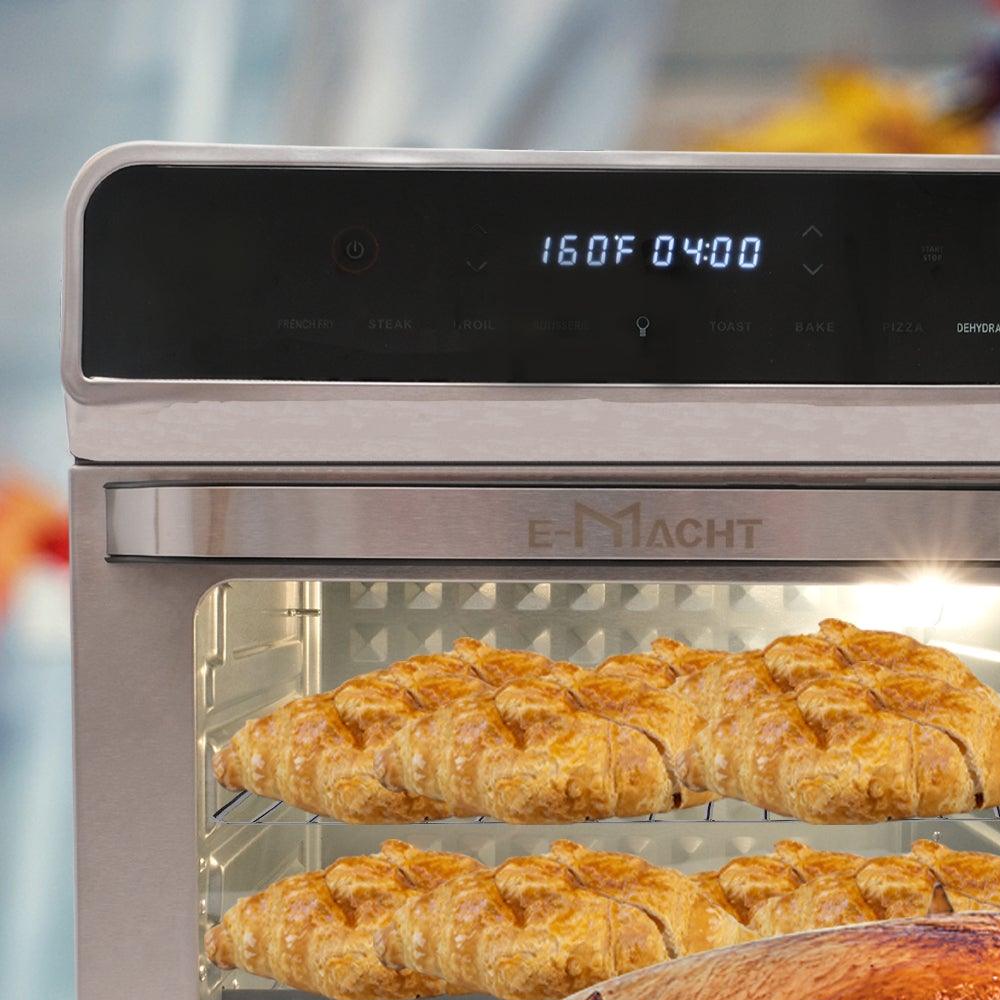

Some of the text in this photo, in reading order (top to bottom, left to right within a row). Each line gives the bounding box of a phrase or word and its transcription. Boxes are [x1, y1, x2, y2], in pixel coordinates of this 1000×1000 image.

[652, 235, 761, 268] 04:00
[367, 319, 413, 330] STEAK
[709, 320, 752, 332] TOAST
[794, 320, 835, 332] BAKE
[882, 321, 925, 333] PIZZA
[528, 501, 763, 549] E-MACHT
